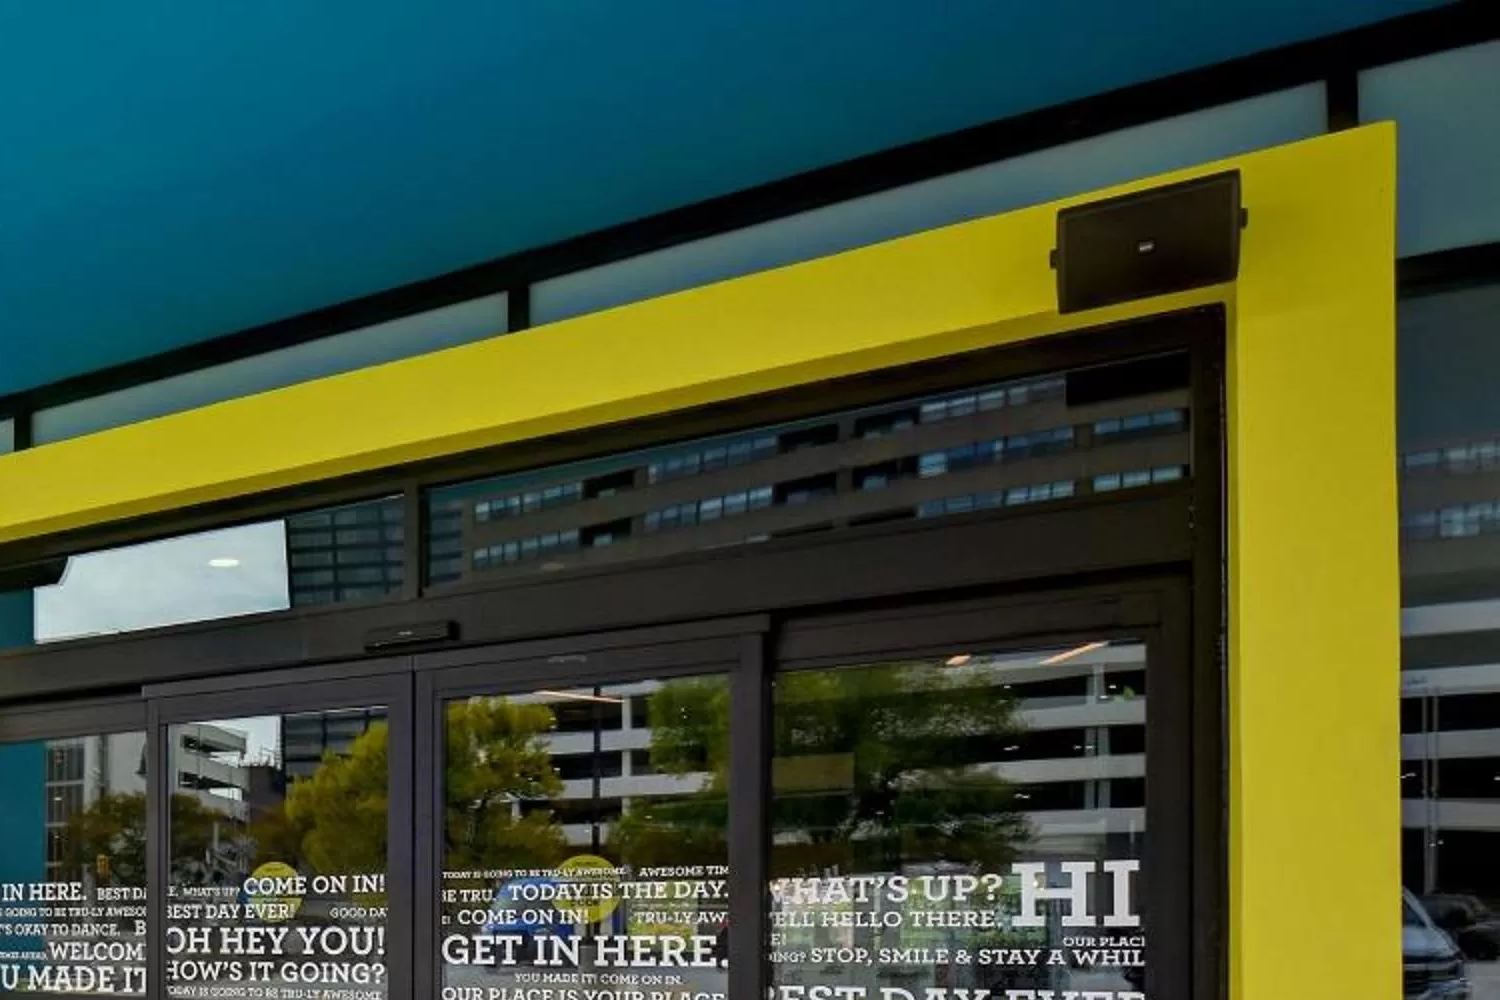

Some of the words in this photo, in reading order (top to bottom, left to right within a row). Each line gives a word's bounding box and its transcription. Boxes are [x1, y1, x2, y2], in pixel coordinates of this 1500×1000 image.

[638, 866, 702, 877] AWESOME
[2, 883, 25, 901] IN
[28, 882, 87, 900] HERE.
[98, 887, 131, 900] BEST
[243, 876, 307, 896] COME
[312, 875, 347, 894] ON
[352, 874, 386, 894] IN!
[460, 889, 497, 902] TRU.
[508, 884, 586, 901] TODAY
[592, 883, 613, 899] IS
[618, 882, 668, 899] THE
[674, 880, 729, 898] DAY.
[769, 876, 908, 904] WHAT'S
[916, 874, 1003, 902] UP?
[1011, 860, 1140, 927] HI
[38, 908, 52, 917] TO
[205, 904, 241, 919] DAY
[244, 903, 296, 919] EVER!
[330, 908, 367, 918] GOOD
[457, 909, 517, 925] COME
[522, 909, 554, 924] ON
[560, 908, 589, 924] IN!
[633, 912, 694, 925] TRU-LY
[697, 912, 729, 924] AW
[770, 911, 816, 928] ELL
[822, 911, 902, 928] HELLO
[909, 910, 1004, 927] THERE.
[15, 923, 48, 936] OKAY
[51, 924, 69, 936] TO
[167, 927, 212, 954] OH
[219, 927, 289, 955] HEY
[296, 926, 386, 955] YOU!
[1063, 937, 1097, 948] OUR
[441, 934, 522, 966] GET
[533, 936, 582, 967] IN
[594, 936, 729, 968] HERE.
[811, 948, 873, 967] STOP,
[879, 948, 949, 964] SMILE
[955, 950, 973, 965] &
[978, 950, 1042, 966] STAY
[1046, 950, 1067, 966] A
[1072, 950, 1146, 966] WHIL
[27, 965, 116, 993] MADE
[248, 961, 274, 982] IT
[280, 962, 386, 984] GOING?
[515, 973, 540, 983] YOU
[544, 973, 579, 984] MADE
[600, 974, 639, 984] COME
[641, 974, 662, 985] ON
[199, 986, 209, 997] IS
[210, 986, 246, 998] GOING
[248, 987, 264, 998] TO
[280, 988, 322, 1000] TRU-LY
